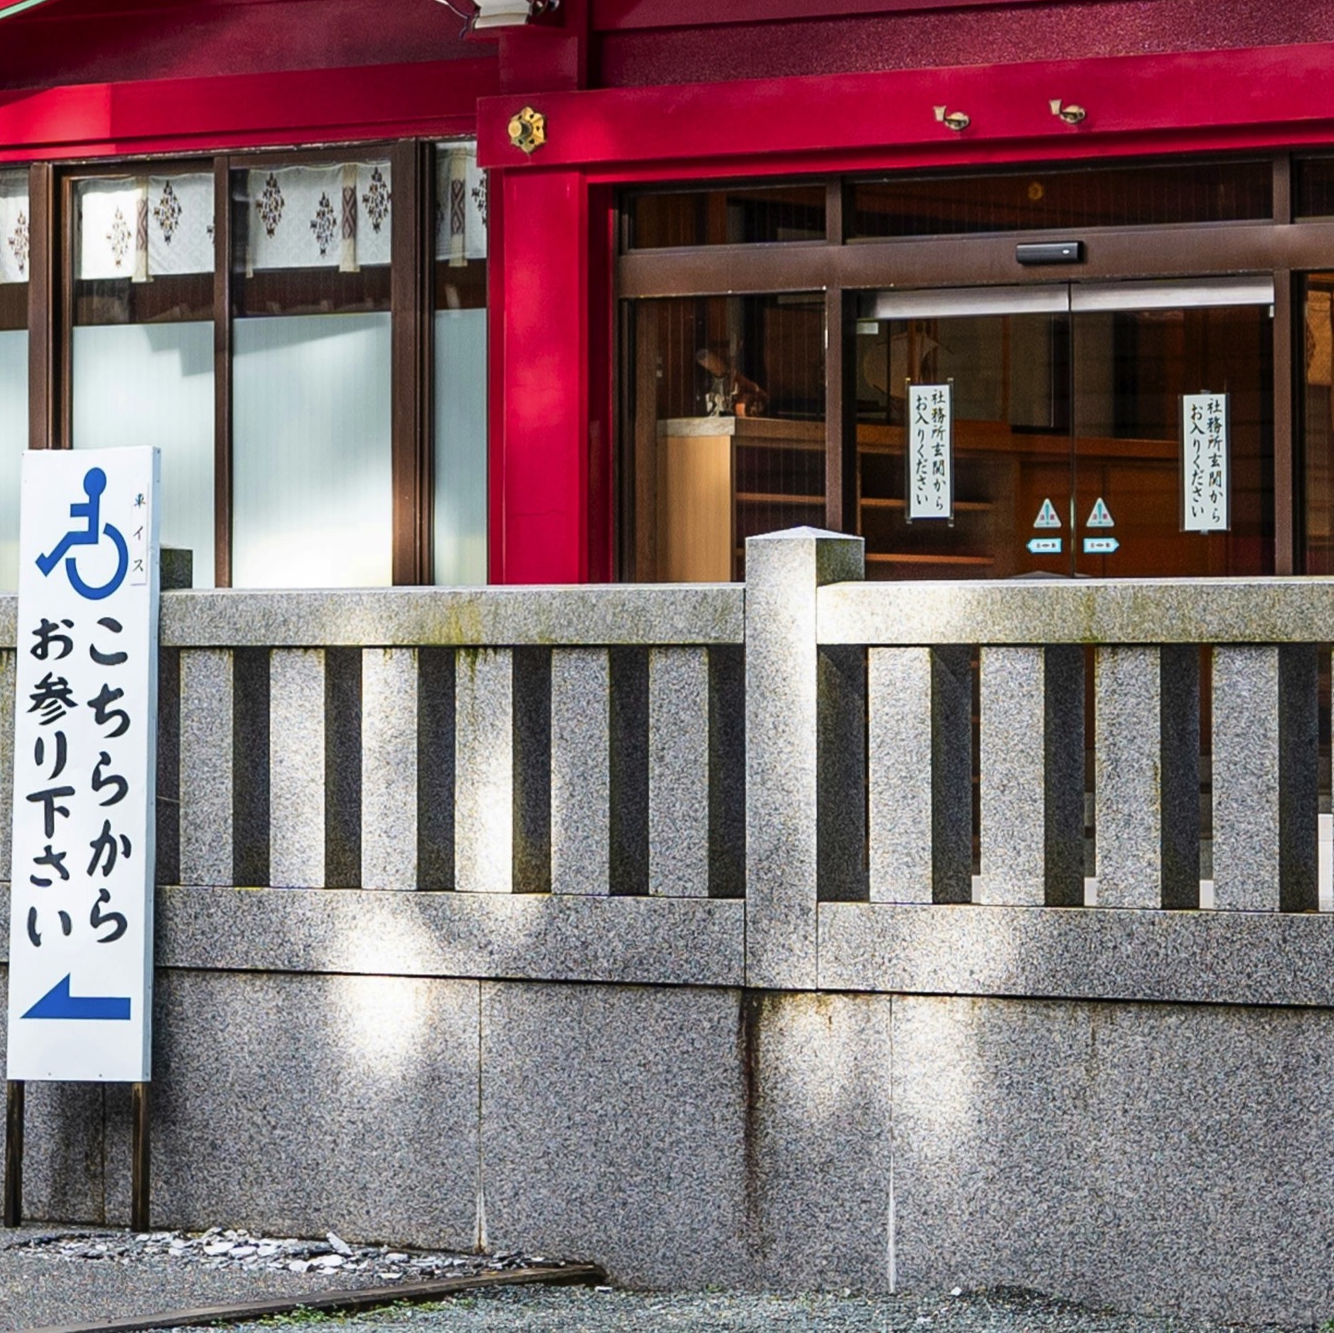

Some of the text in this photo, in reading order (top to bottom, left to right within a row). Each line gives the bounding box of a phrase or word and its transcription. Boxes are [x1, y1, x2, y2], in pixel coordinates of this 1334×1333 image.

[915, 394, 929, 505] お入りください
[931, 389, 946, 510] 社務所玄関から
[1190, 403, 1205, 517] お入りください
[1207, 398, 1223, 523] 社務所玄関から
[26, 617, 79, 947] お参り下さい
[87, 617, 132, 943] こちらから
